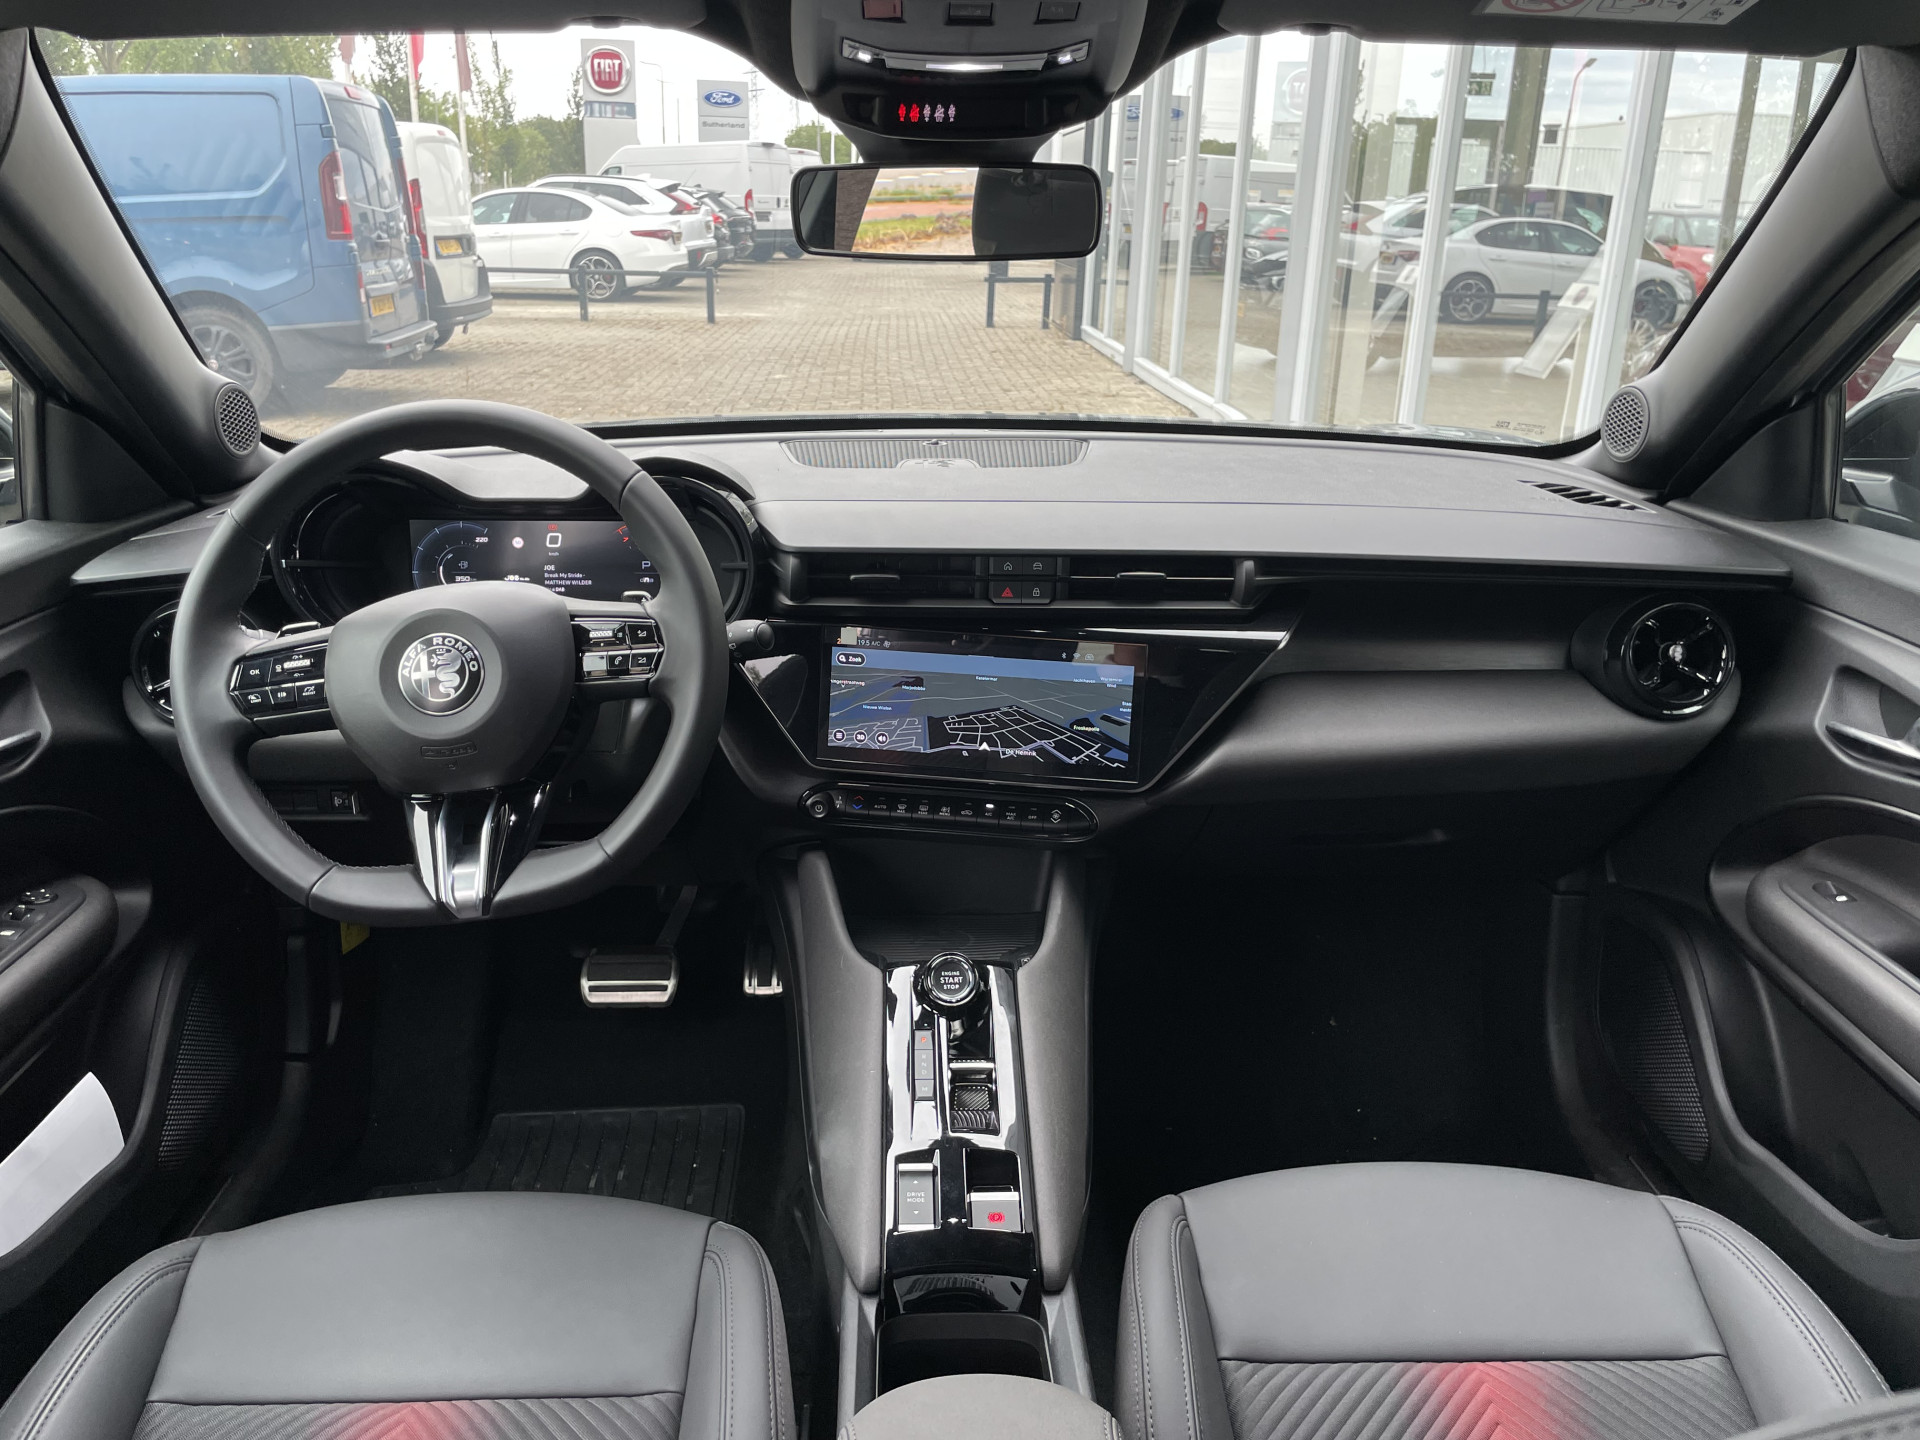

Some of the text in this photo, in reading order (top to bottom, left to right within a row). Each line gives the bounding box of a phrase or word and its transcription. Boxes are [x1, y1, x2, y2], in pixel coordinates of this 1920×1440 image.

[593, 58, 622, 82] FIAT
[709, 91, 735, 104] Ford
[701, 120, 746, 129] Sutherland
[642, 561, 651, 570] P
[402, 636, 479, 678] ALFA ROMEO
